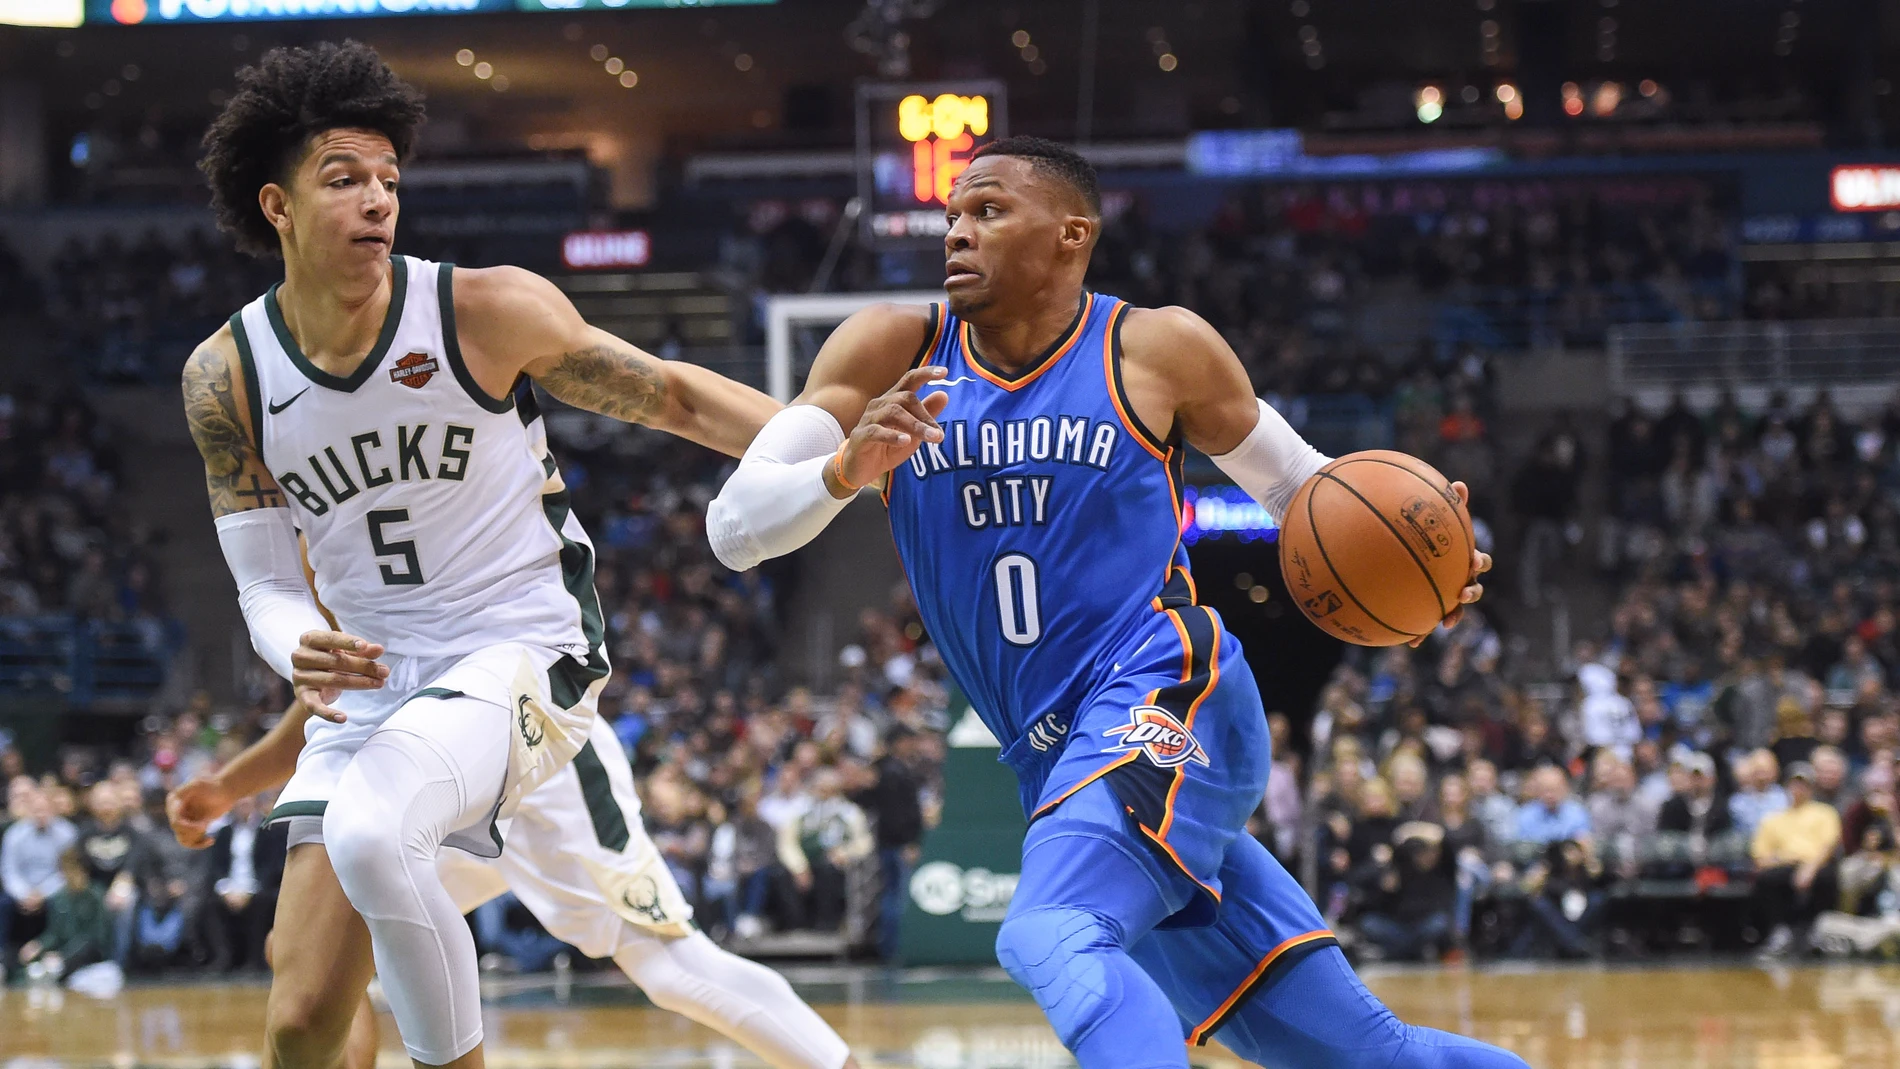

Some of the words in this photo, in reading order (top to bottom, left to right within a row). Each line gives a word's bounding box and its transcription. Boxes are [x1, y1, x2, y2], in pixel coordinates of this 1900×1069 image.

[277, 423, 476, 518] BUCKS
[961, 477, 1051, 528] CITY
[365, 507, 426, 586] 5
[993, 553, 1042, 647] 0
[1028, 712, 1068, 753] OKC
[1125, 720, 1186, 748] OKC
